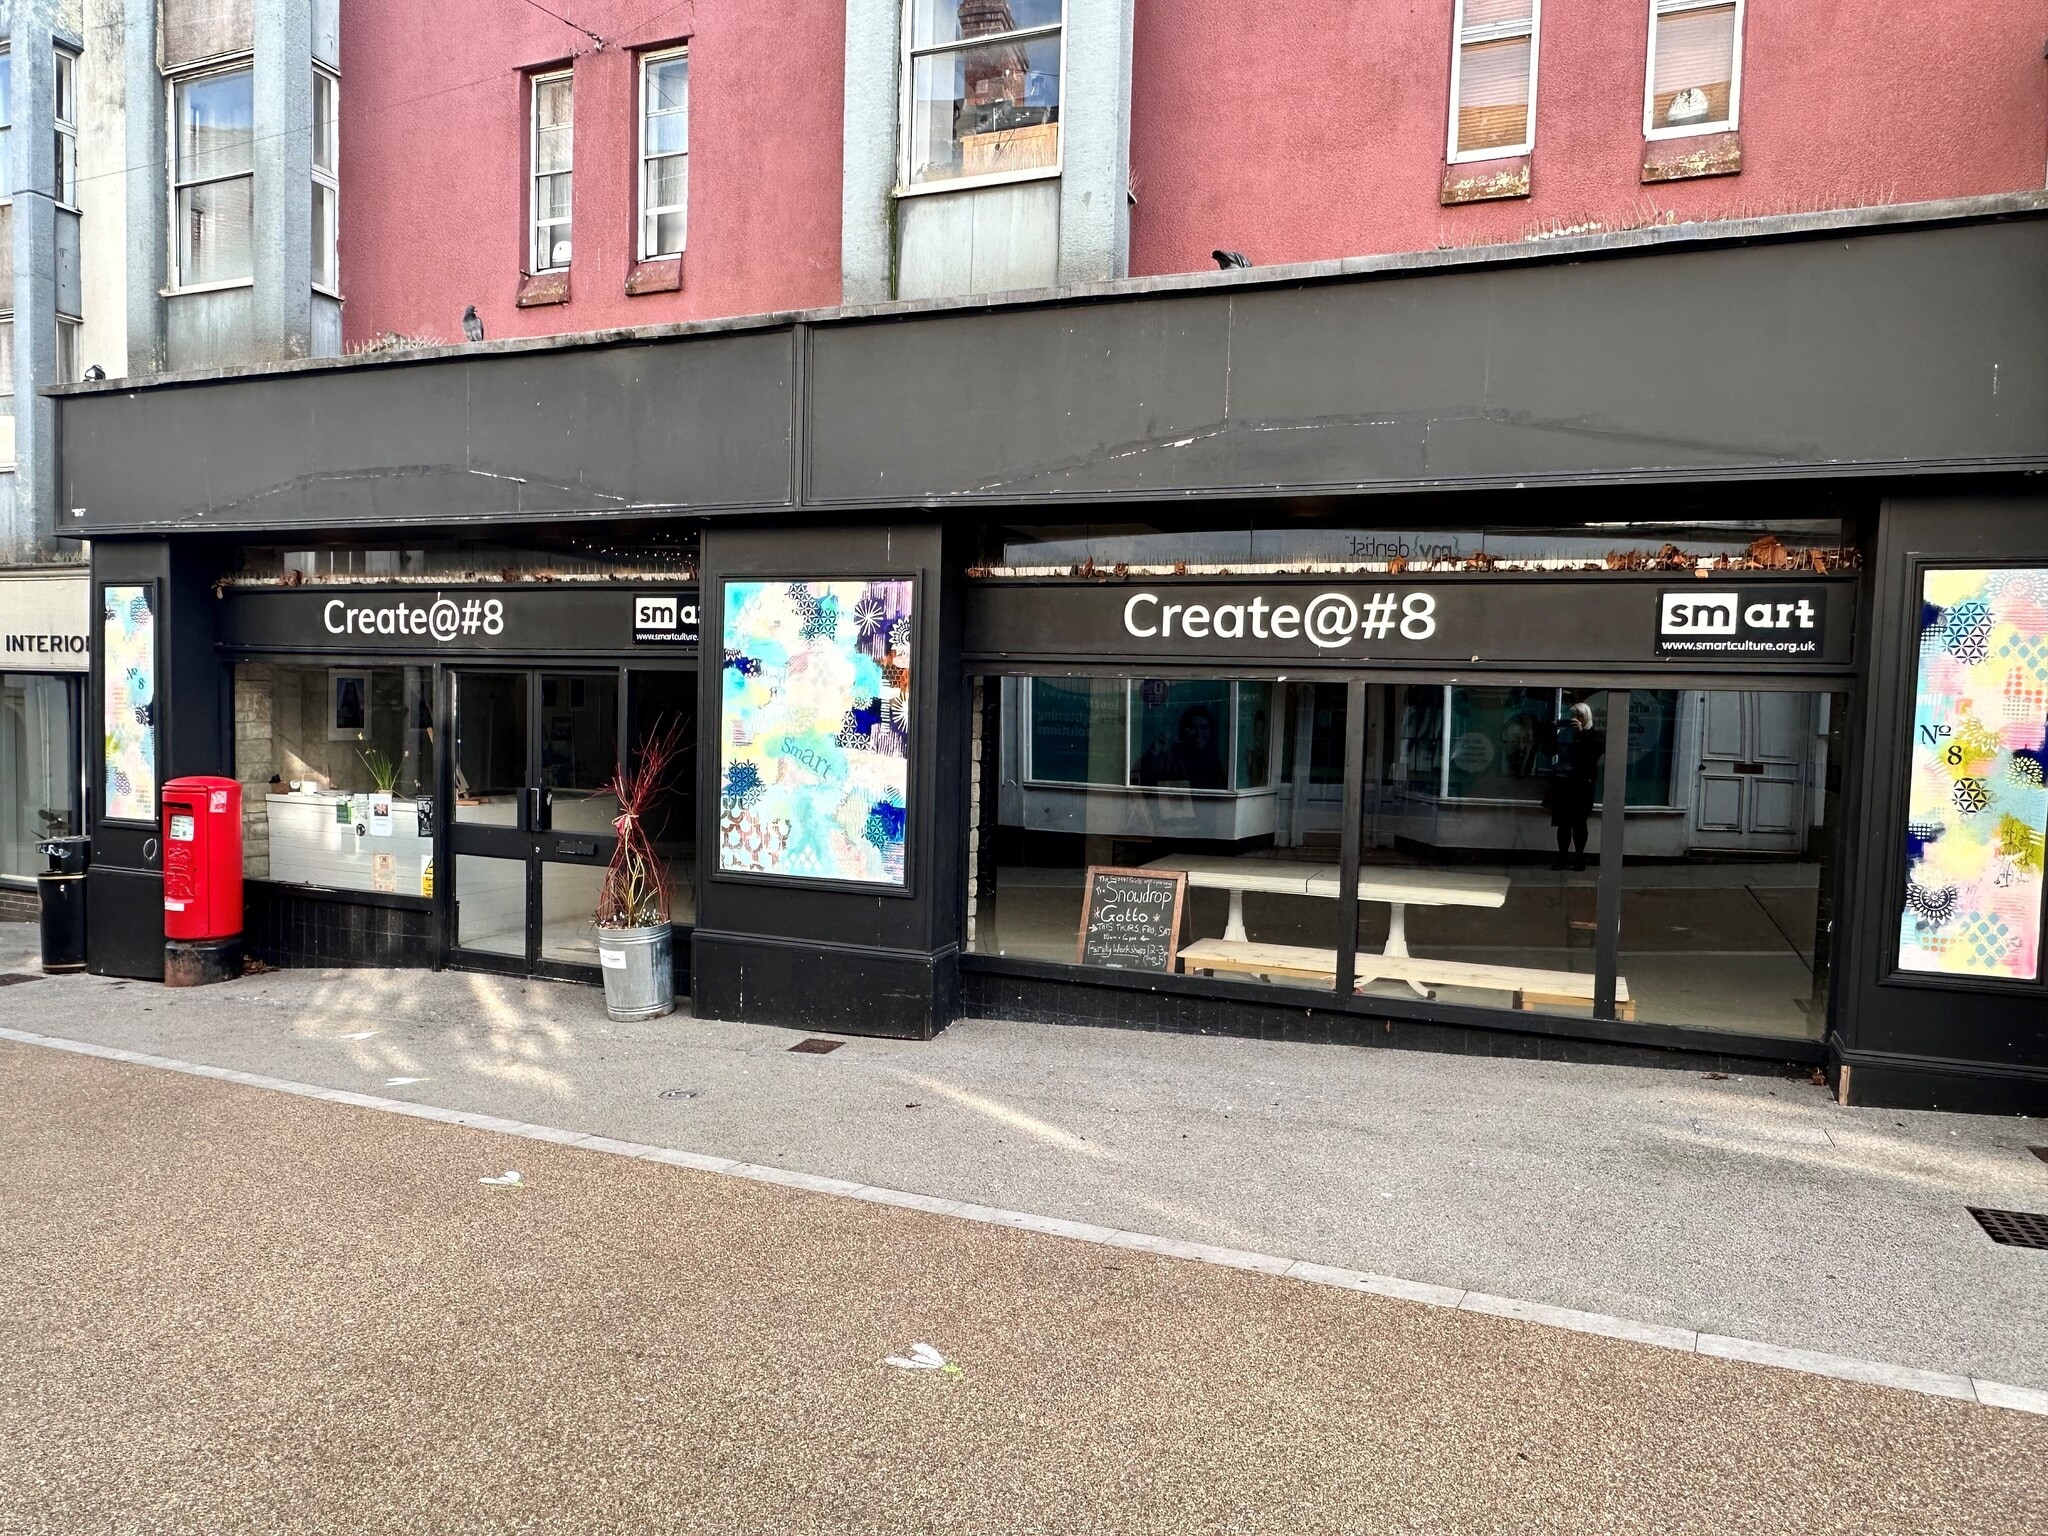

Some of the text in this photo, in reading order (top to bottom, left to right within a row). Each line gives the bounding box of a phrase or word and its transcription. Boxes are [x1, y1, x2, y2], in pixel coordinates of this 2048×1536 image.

[324, 599, 504, 642] Create@#8
[680, 605, 700, 624] a
[1123, 592, 1437, 648] Create@#8
[6, 634, 89, 653] INTERIO
[1661, 640, 1816, 653] www.smartculture.org.uk
[1947, 745, 1962, 765] 8
[1103, 881, 1172, 910] Snowdrop
